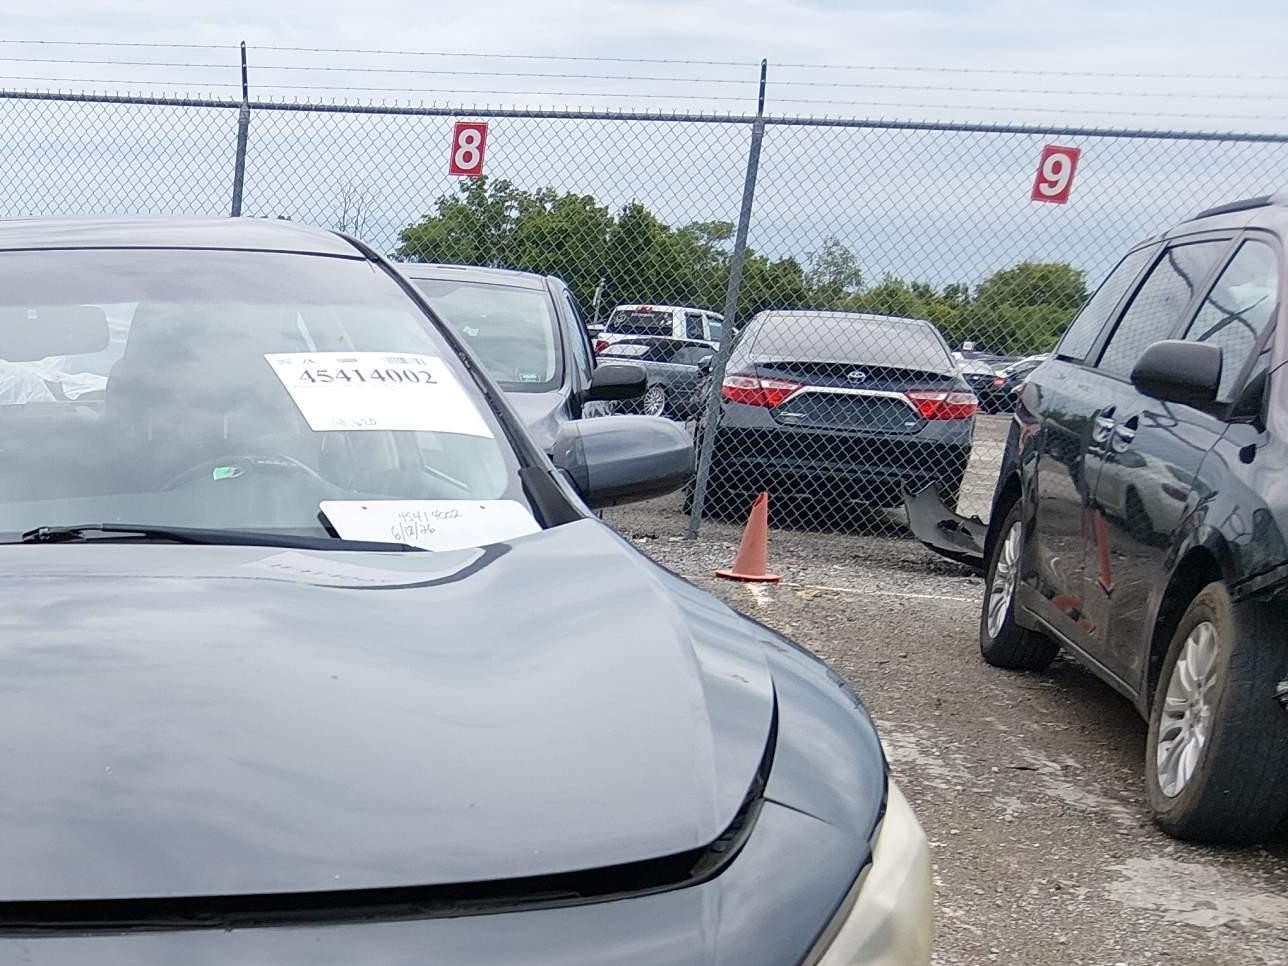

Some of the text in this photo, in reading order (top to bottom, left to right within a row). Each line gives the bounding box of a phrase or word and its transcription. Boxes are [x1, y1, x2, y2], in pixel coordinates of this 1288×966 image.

[454, 127, 482, 171] 8
[1040, 153, 1071, 196] 9
[299, 369, 438, 384] 45414002
